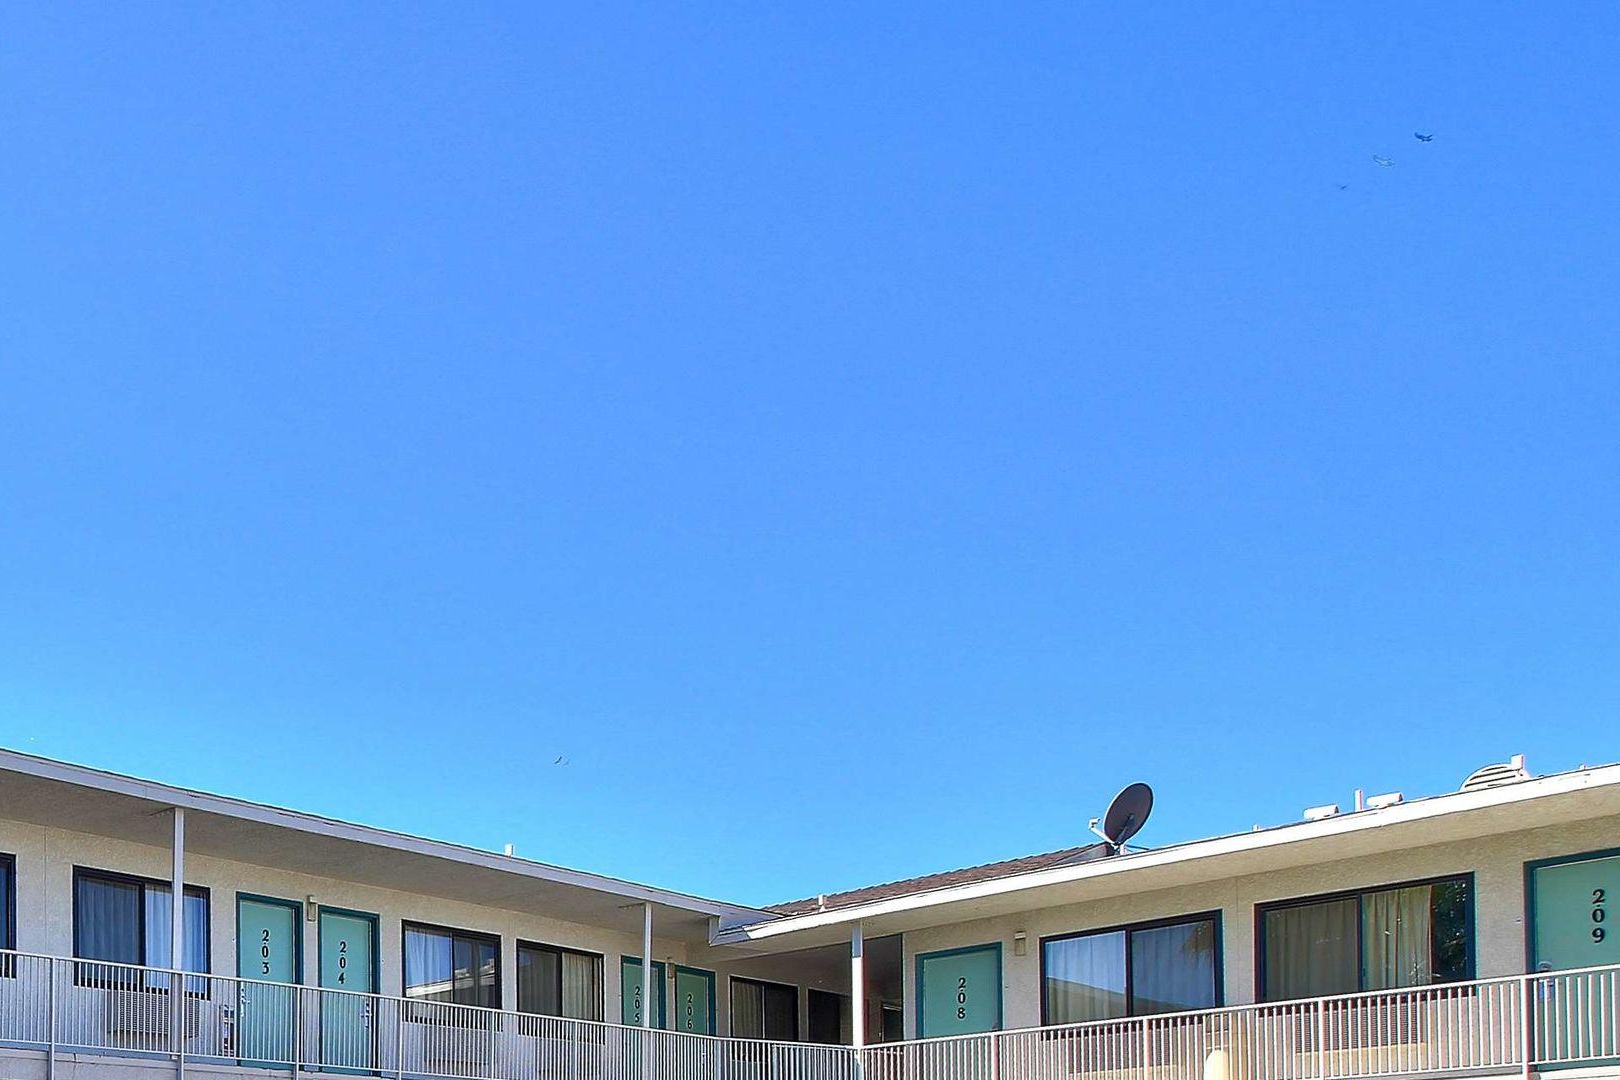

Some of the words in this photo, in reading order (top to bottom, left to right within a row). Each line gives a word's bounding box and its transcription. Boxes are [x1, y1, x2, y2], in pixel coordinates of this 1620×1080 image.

[1591, 888, 1606, 944] 209
[261, 929, 270, 975] 203
[338, 940, 347, 985] 204
[957, 977, 967, 1020] 208
